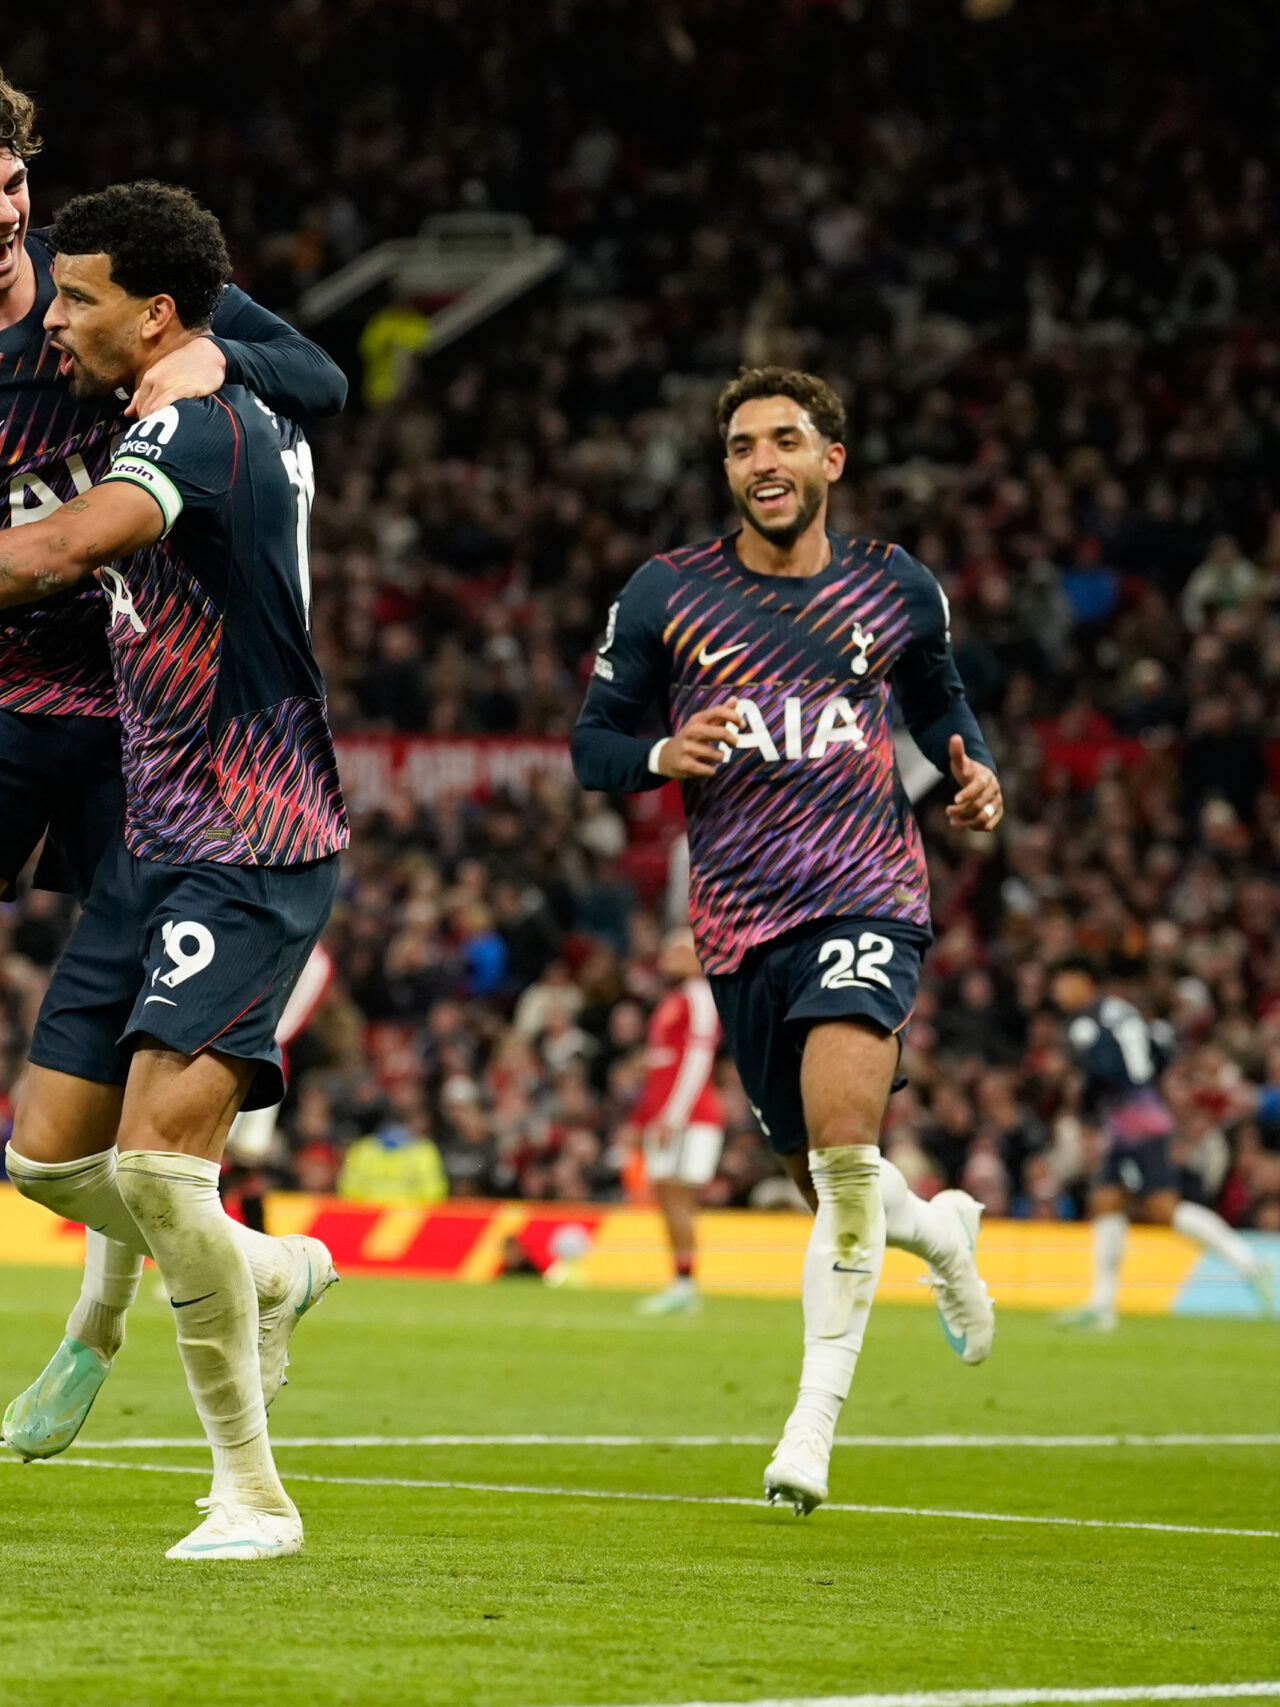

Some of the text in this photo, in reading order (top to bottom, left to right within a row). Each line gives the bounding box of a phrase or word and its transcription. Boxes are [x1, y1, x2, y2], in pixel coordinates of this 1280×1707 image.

[9, 447, 102, 528] AI
[114, 463, 154, 481] tain
[719, 697, 867, 763] AIA
[818, 931, 894, 990] 22
